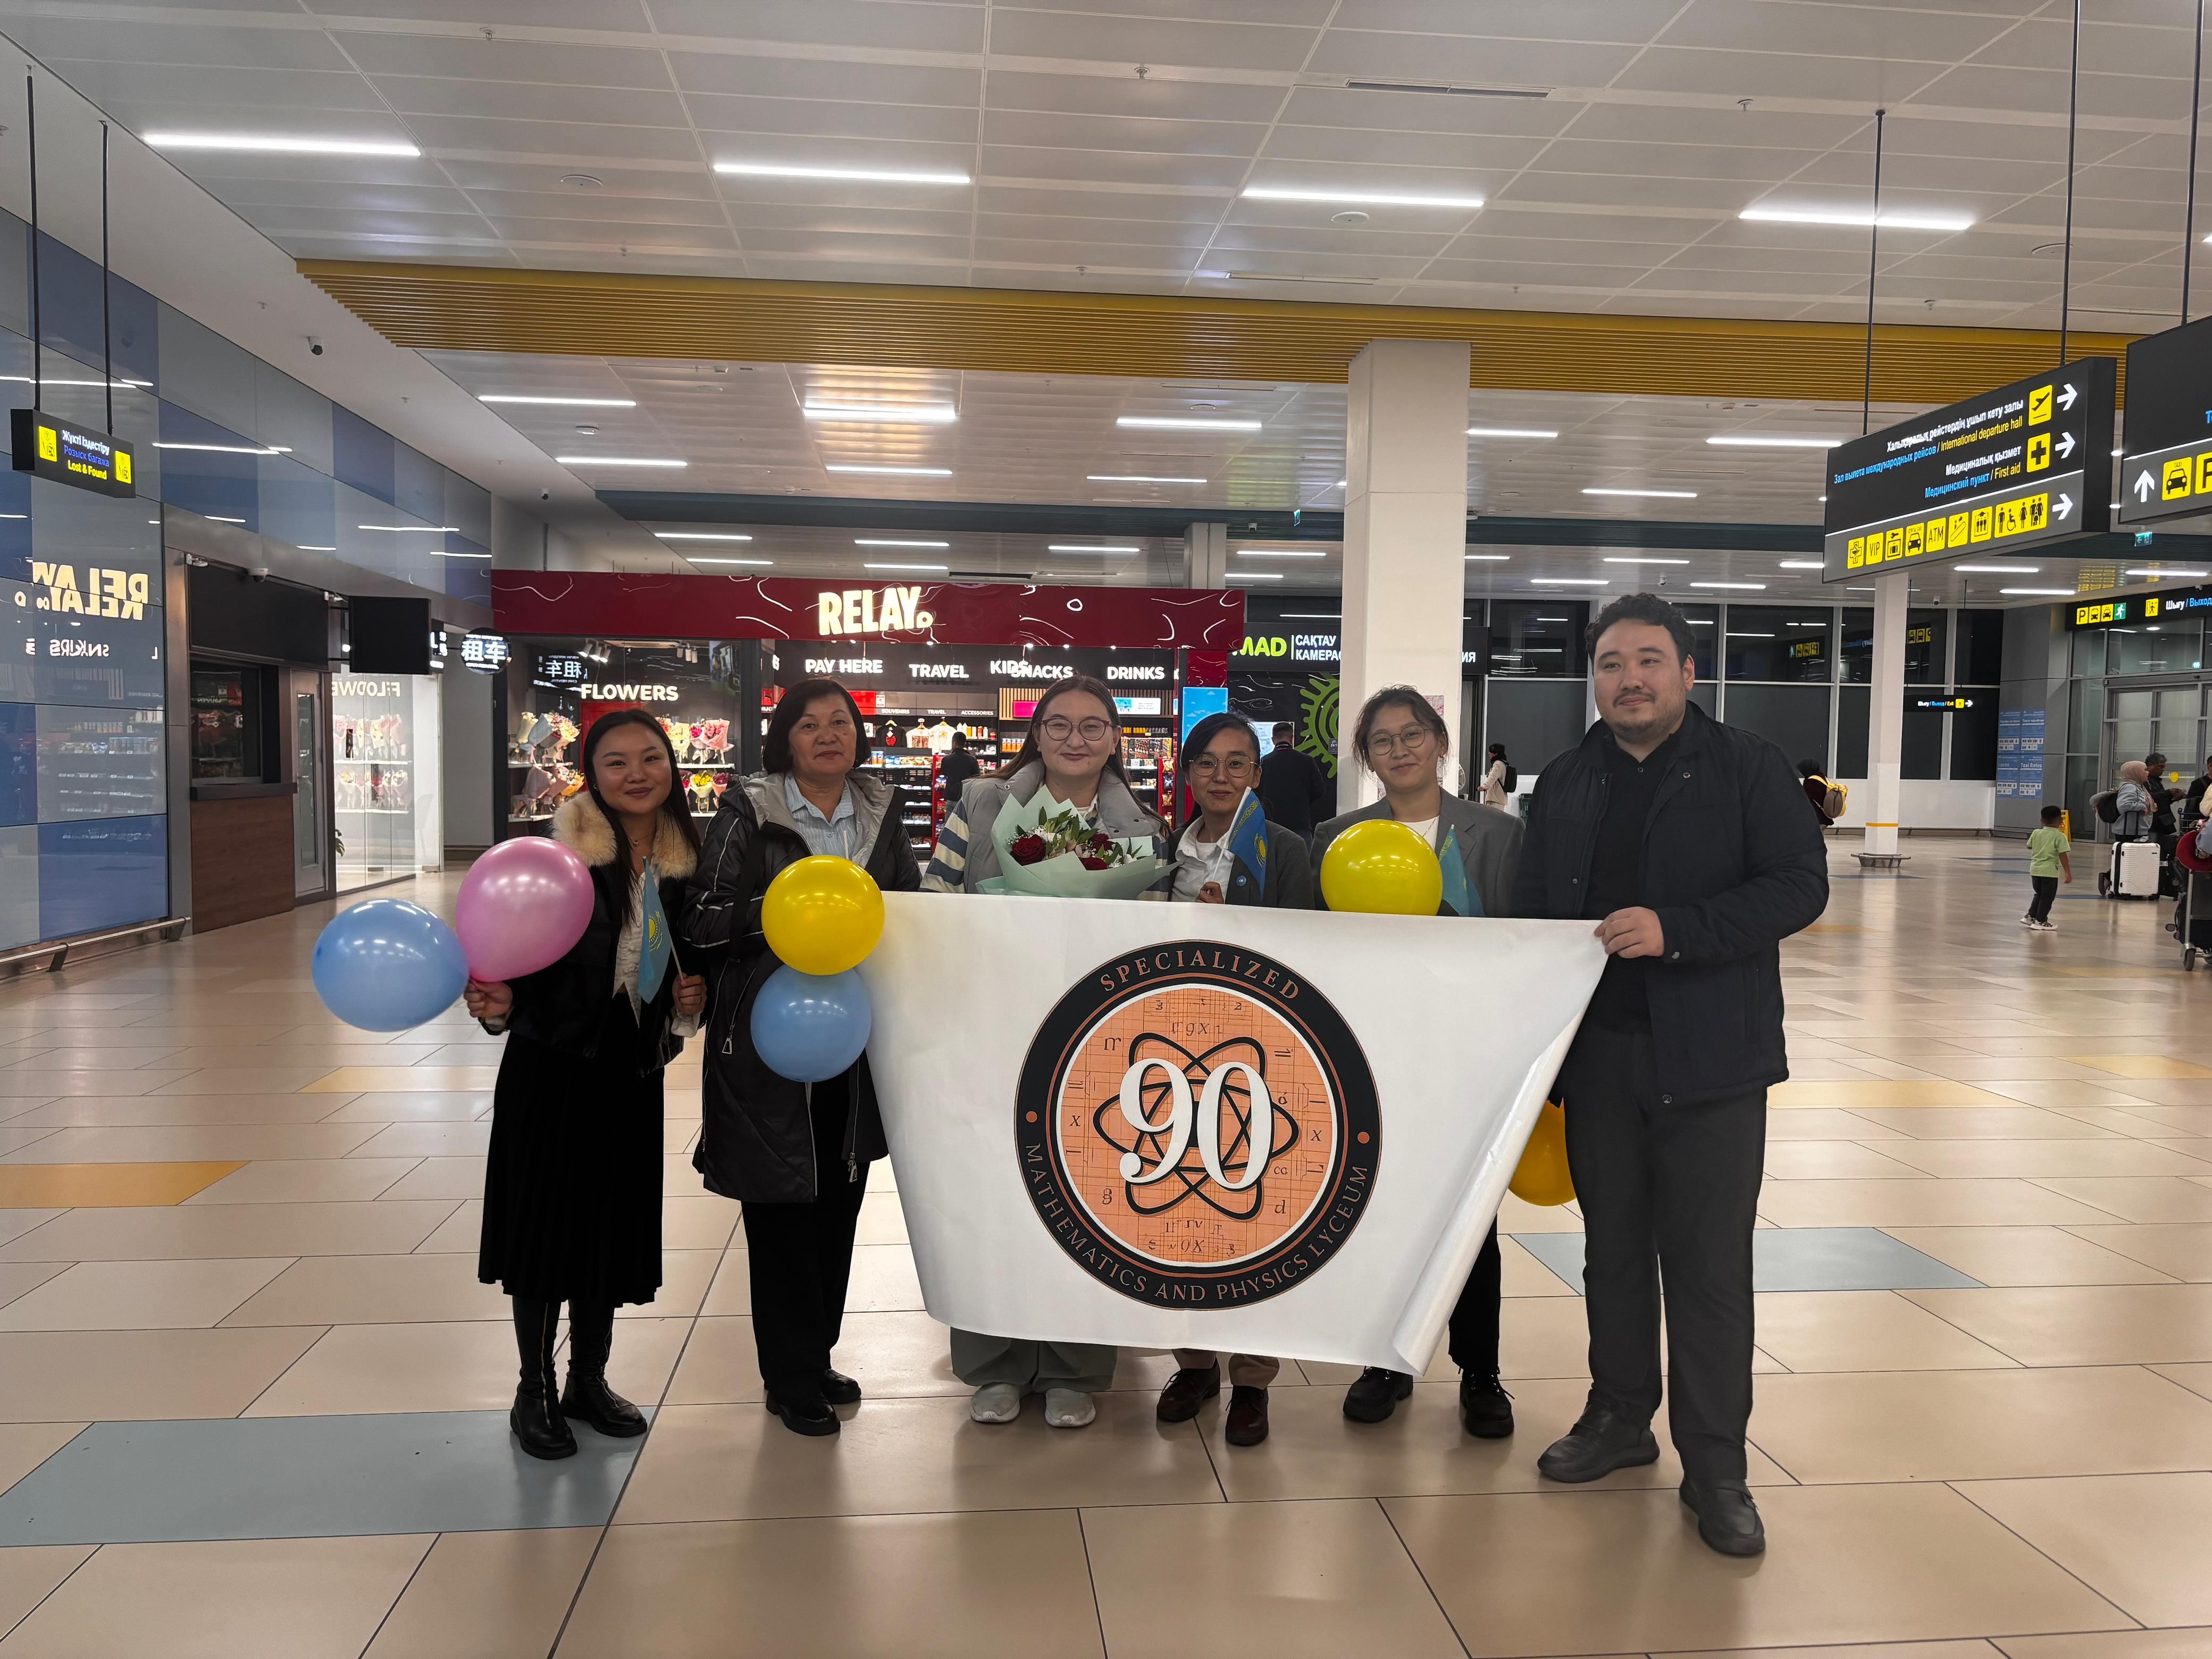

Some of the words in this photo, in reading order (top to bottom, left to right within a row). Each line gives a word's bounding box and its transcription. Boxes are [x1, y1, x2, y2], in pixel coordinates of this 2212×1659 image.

[1929, 418, 1966, 441] рейстердің
[1966, 412, 1986, 429] ұшып
[1988, 407, 2003, 419] кету
[2004, 400, 2024, 414] залы
[64, 445, 87, 460] Розыск
[88, 453, 110, 467] багажа
[1834, 474, 1845, 484] Зал
[1845, 468, 1865, 481] вылета
[1866, 455, 1913, 473] международных
[1914, 446, 1937, 462] рейсов
[1941, 430, 1978, 451] International
[1979, 422, 2009, 440] departure
[2010, 415, 2022, 430] hall
[68, 459, 81, 473] Lost
[82, 464, 87, 474] &
[88, 465, 107, 480] Found
[1946, 454, 1994, 476] Медициналық
[1995, 446, 2022, 463] қызмет
[1925, 476, 1968, 498] Медицинский
[1970, 473, 1990, 488] пункт
[1995, 467, 2009, 479] First
[2010, 462, 2021, 475] aid
[1928, 526, 1944, 543] ATM
[1870, 541, 1880, 557] VIP
[818, 586, 922, 636] RELAY
[461, 639, 506, 664] 租车
[1295, 634, 1336, 648] САҚТАУ
[805, 659, 836, 674] PAY
[840, 659, 884, 674] HERE
[909, 664, 970, 678] TRAVEL
[1011, 665, 1074, 679] SNACKS
[1107, 666, 1165, 680] DRINKS
[581, 684, 679, 701] FLOWERS
[1100, 950, 1299, 1000] SPECIALIZED
[1119, 1058, 1274, 1189] 90
[1025, 1143, 1146, 1292] MATHEMATICS
[1154, 1283, 1206, 1301] AND
[1216, 1253, 1309, 1300] PHYSICS
[1308, 1165, 1368, 1258] LYCEUM
